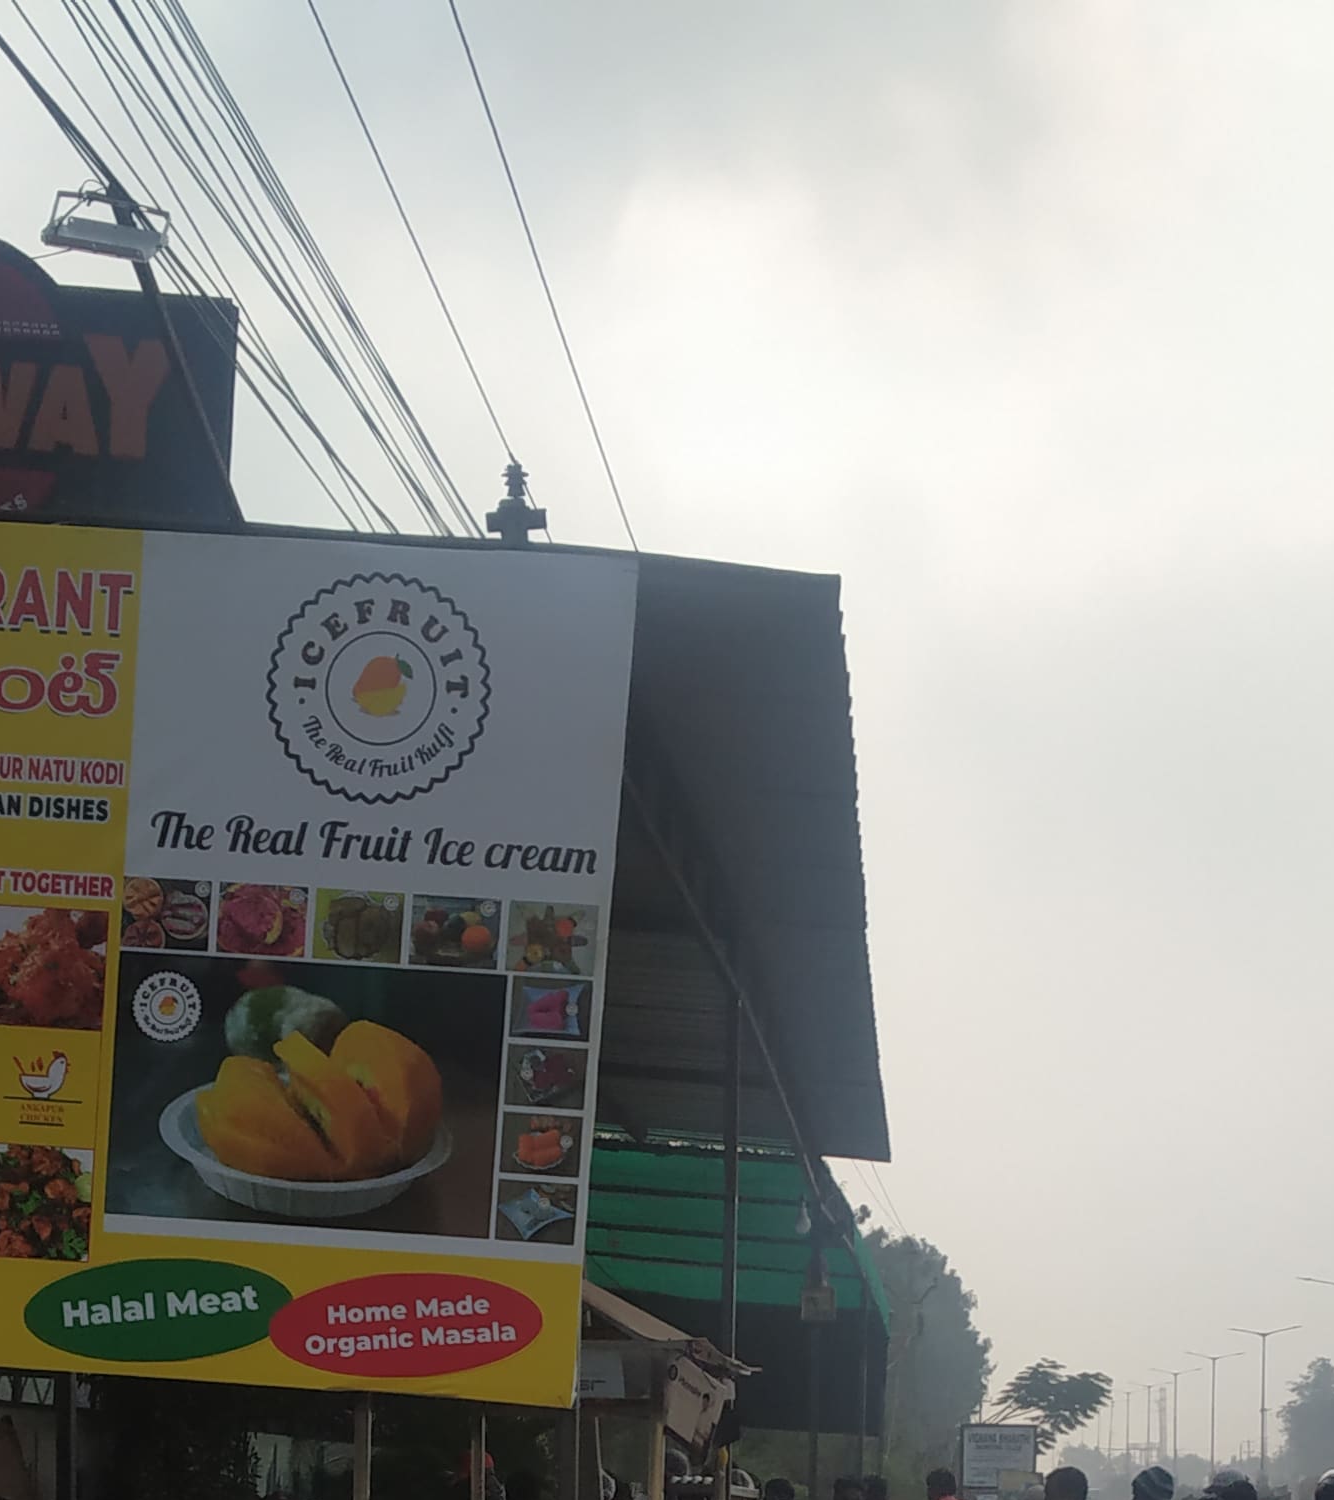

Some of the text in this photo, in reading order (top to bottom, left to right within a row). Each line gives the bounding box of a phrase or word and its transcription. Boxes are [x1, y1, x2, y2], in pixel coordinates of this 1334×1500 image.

[294, 599, 469, 698] ICEFRUIT
[27, 757, 75, 783] NATU
[79, 760, 123, 785] KODI
[28, 795, 108, 821] DISHES
[150, 810, 597, 874] The Real Fruit Ice cream
[9, 870, 113, 897] TOGETHER
[61, 1285, 259, 1327] Halal Meat
[327, 1294, 489, 1324] Home Made
[304, 1321, 516, 1357] Organic Masala
